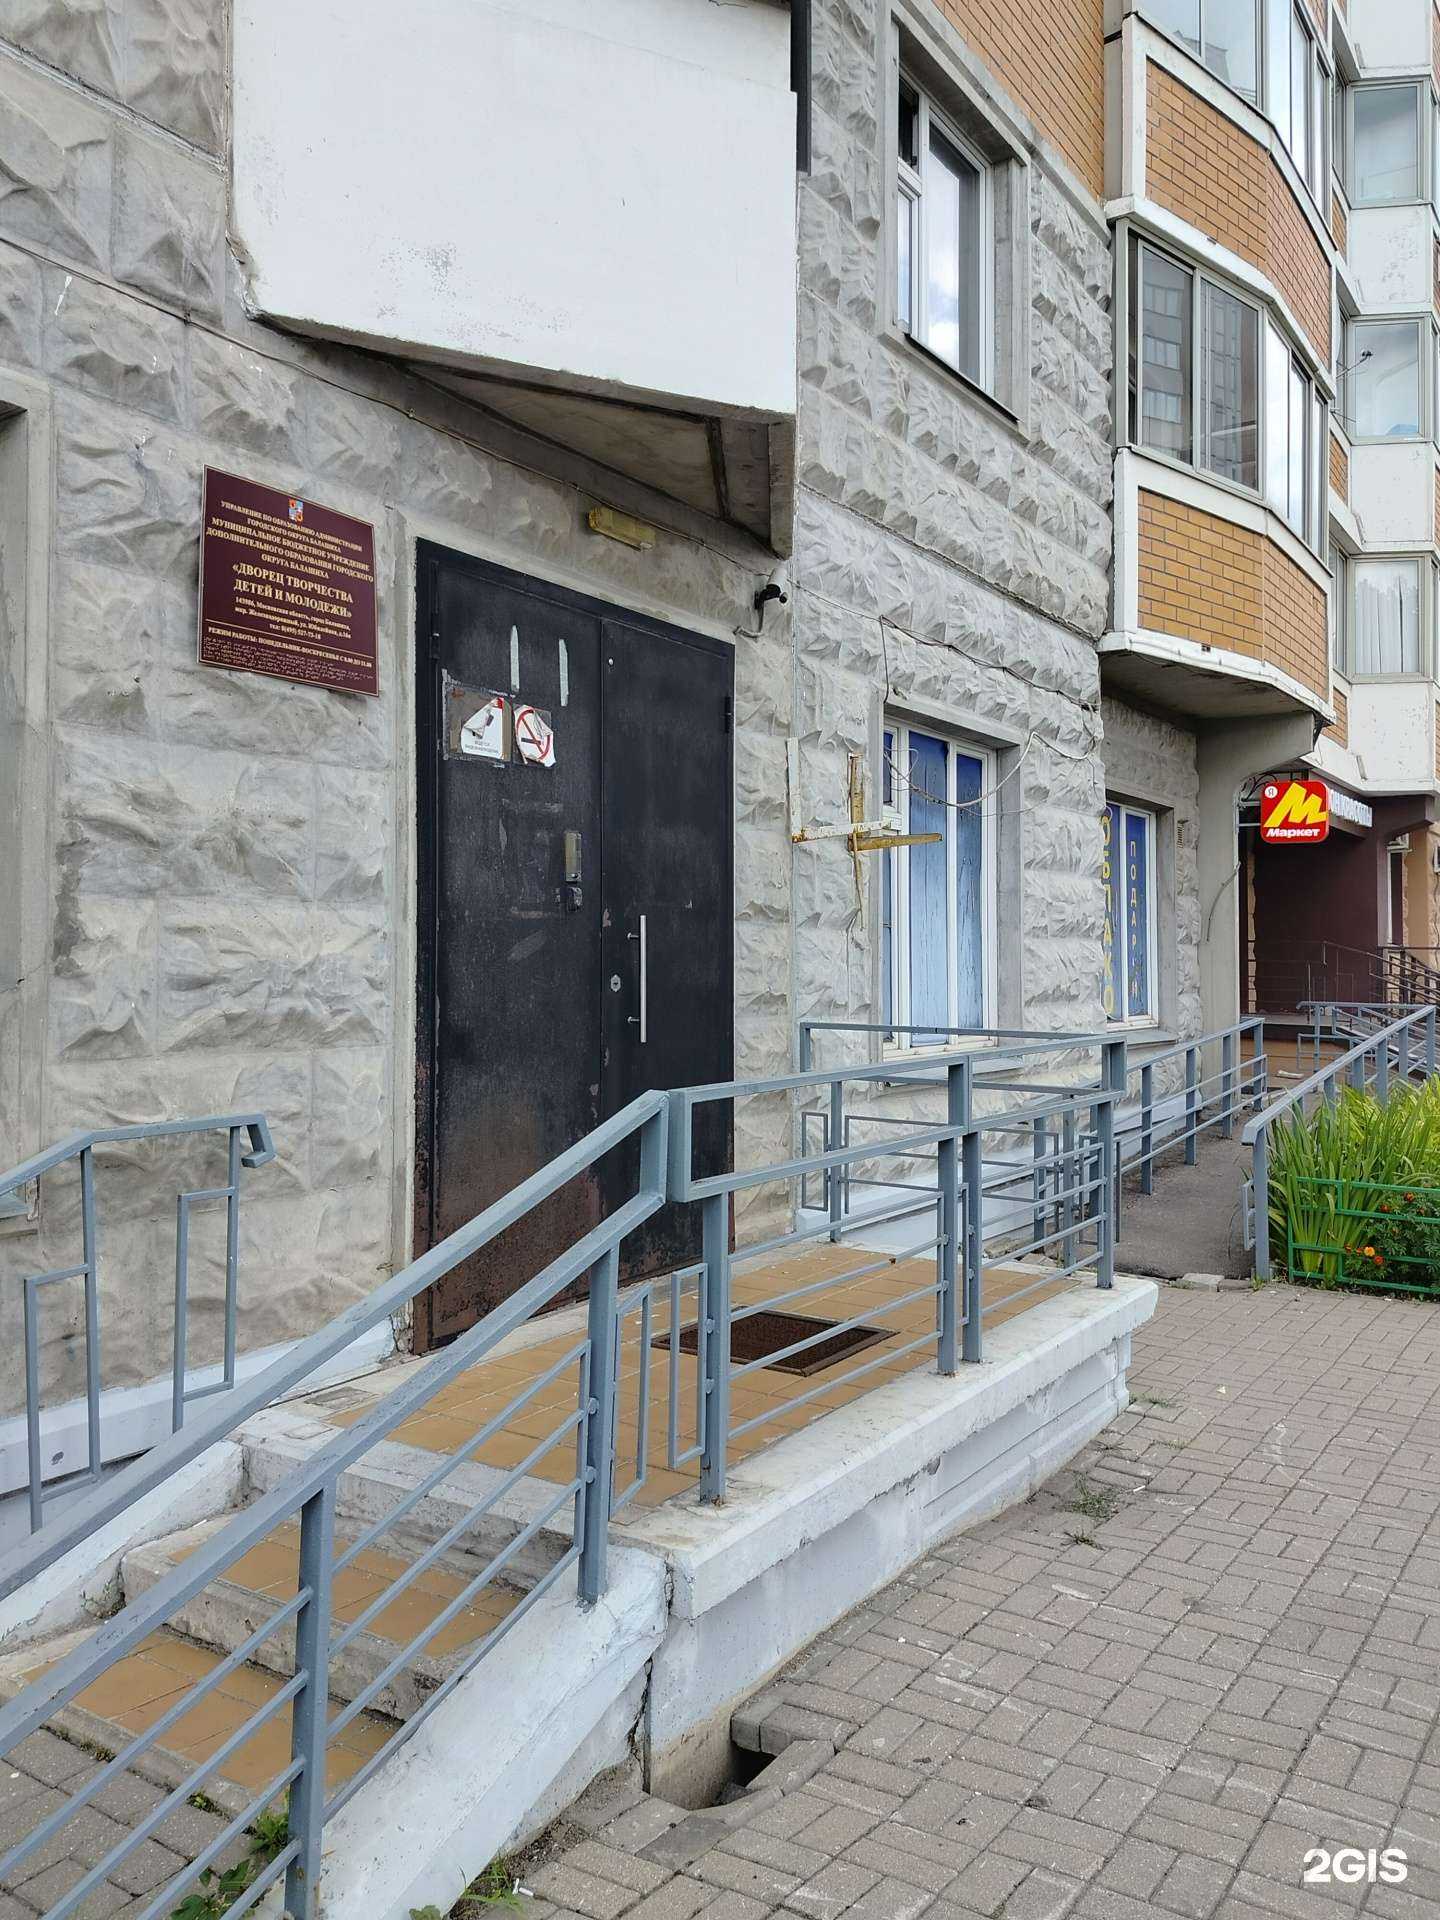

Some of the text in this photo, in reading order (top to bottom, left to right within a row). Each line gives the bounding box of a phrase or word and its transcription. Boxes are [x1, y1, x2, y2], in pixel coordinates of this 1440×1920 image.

[211, 517, 370, 571] МУНИЦИПАЛЬНОЕ БЮДЖЕТНОЕ УЧРЕЖДЕНИЕ
[221, 500, 363, 552] УПРАВЛЕНИЕ ПО ОБРАЗОВАНИЮ АДМИНИСТРАЦИИ
[247, 518, 341, 553] ГОРОДСКОГО ОКРУГА БАЛАШИХА
[206, 527, 374, 582] ДОПОЛНИТЕЛЬНОГО ОБРАЗОВАНИЯ ГОРОДСКОГО
[261, 554, 330, 579] ОКРУГА БАЛАШИХА
[232, 562, 353, 603] «ДВОРЕЦ ТВОРЧЕСТВА
[233, 579, 352, 618] ДЕТЕЙ И МОЛОДЕЖИ»
[208, 626, 231, 637] РЕЖИМ
[232, 630, 257, 643] РАБОТЫ:
[1266, 828, 1321, 839] Маркет
